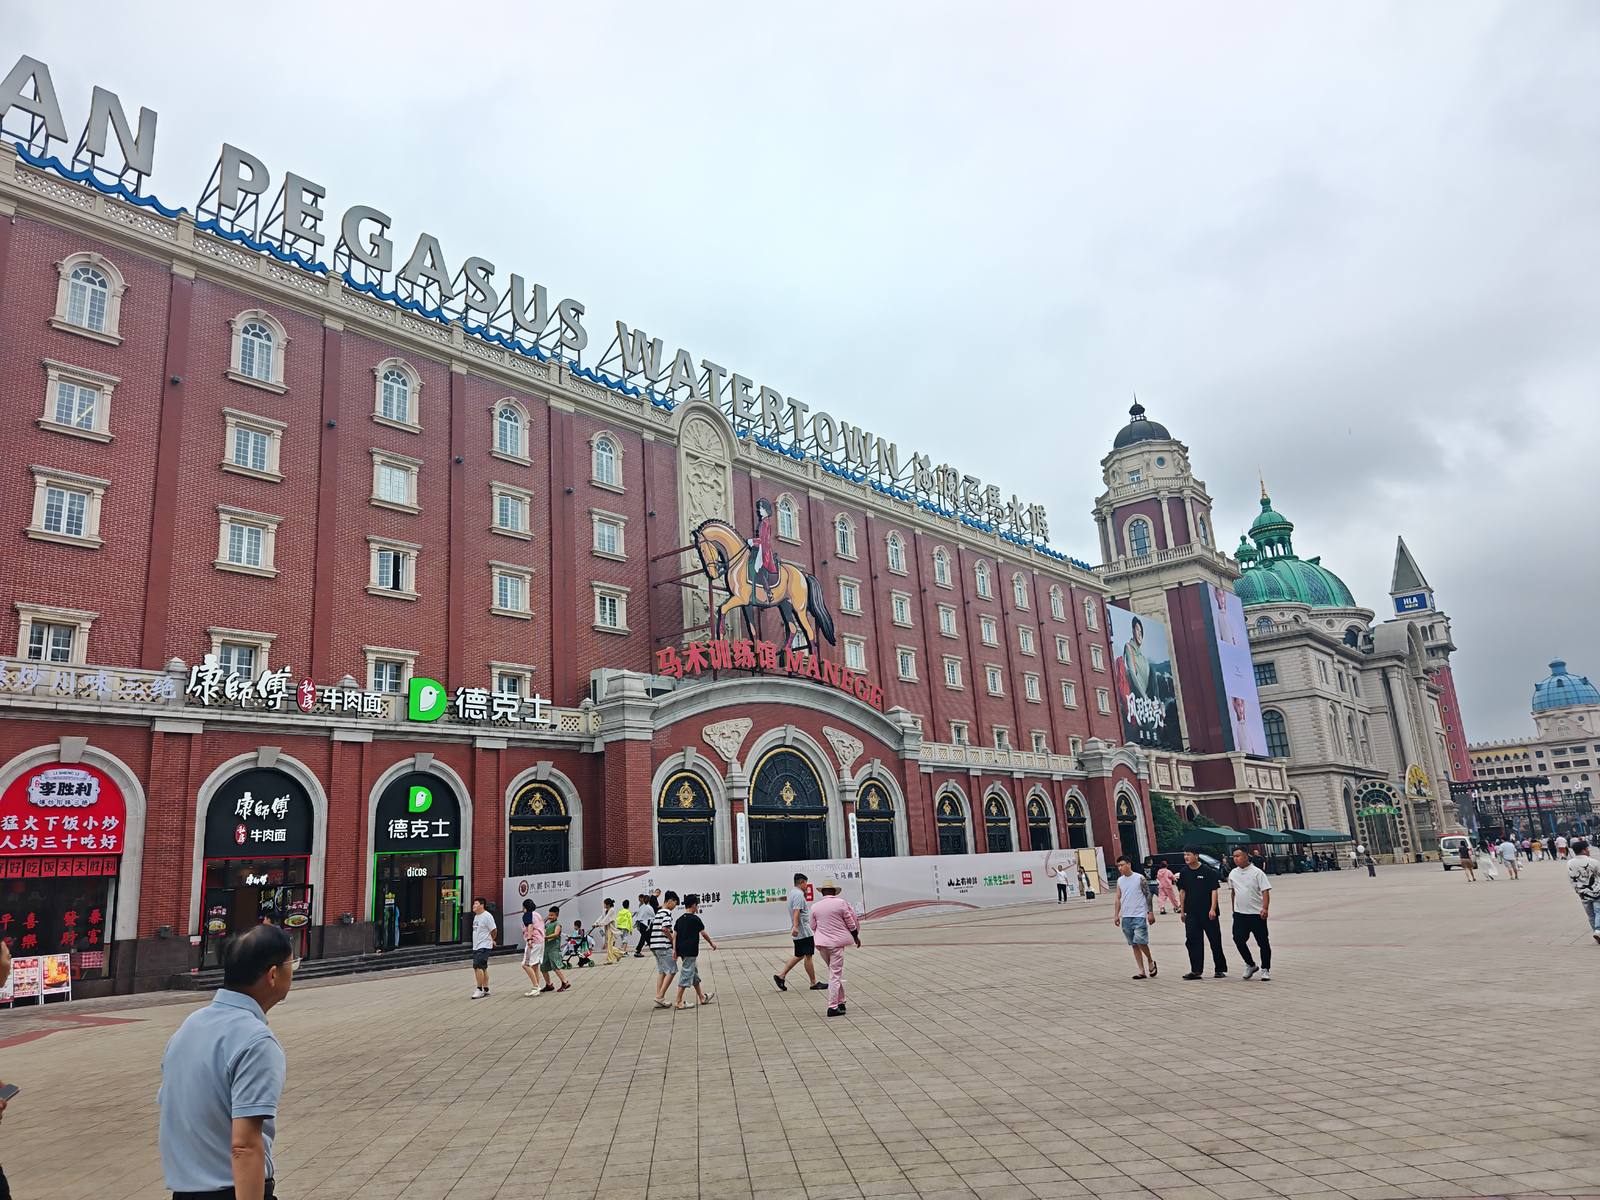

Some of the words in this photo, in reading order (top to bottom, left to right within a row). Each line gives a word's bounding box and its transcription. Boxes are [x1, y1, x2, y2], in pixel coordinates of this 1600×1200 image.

[219, 142, 589, 351] PEGASUS
[615, 320, 900, 481] WATERTOWN
[1402, 596, 1418, 605] HLA
[655, 638, 779, 679] 马术训练馆
[784, 646, 885, 712] MANEGE
[322, 688, 382, 714] 牛肉面
[455, 686, 552, 725] 德克士
[39, 781, 92, 797] 李胜利
[1, 815, 119, 831] 猛火下饭小炒
[387, 819, 450, 839] 德克士
[0, 834, 118, 850] 人均三十吃好
[250, 829, 287, 843] 牛肉面
[406, 866, 428, 877] dicos
[732, 890, 766, 906] 大米先生
